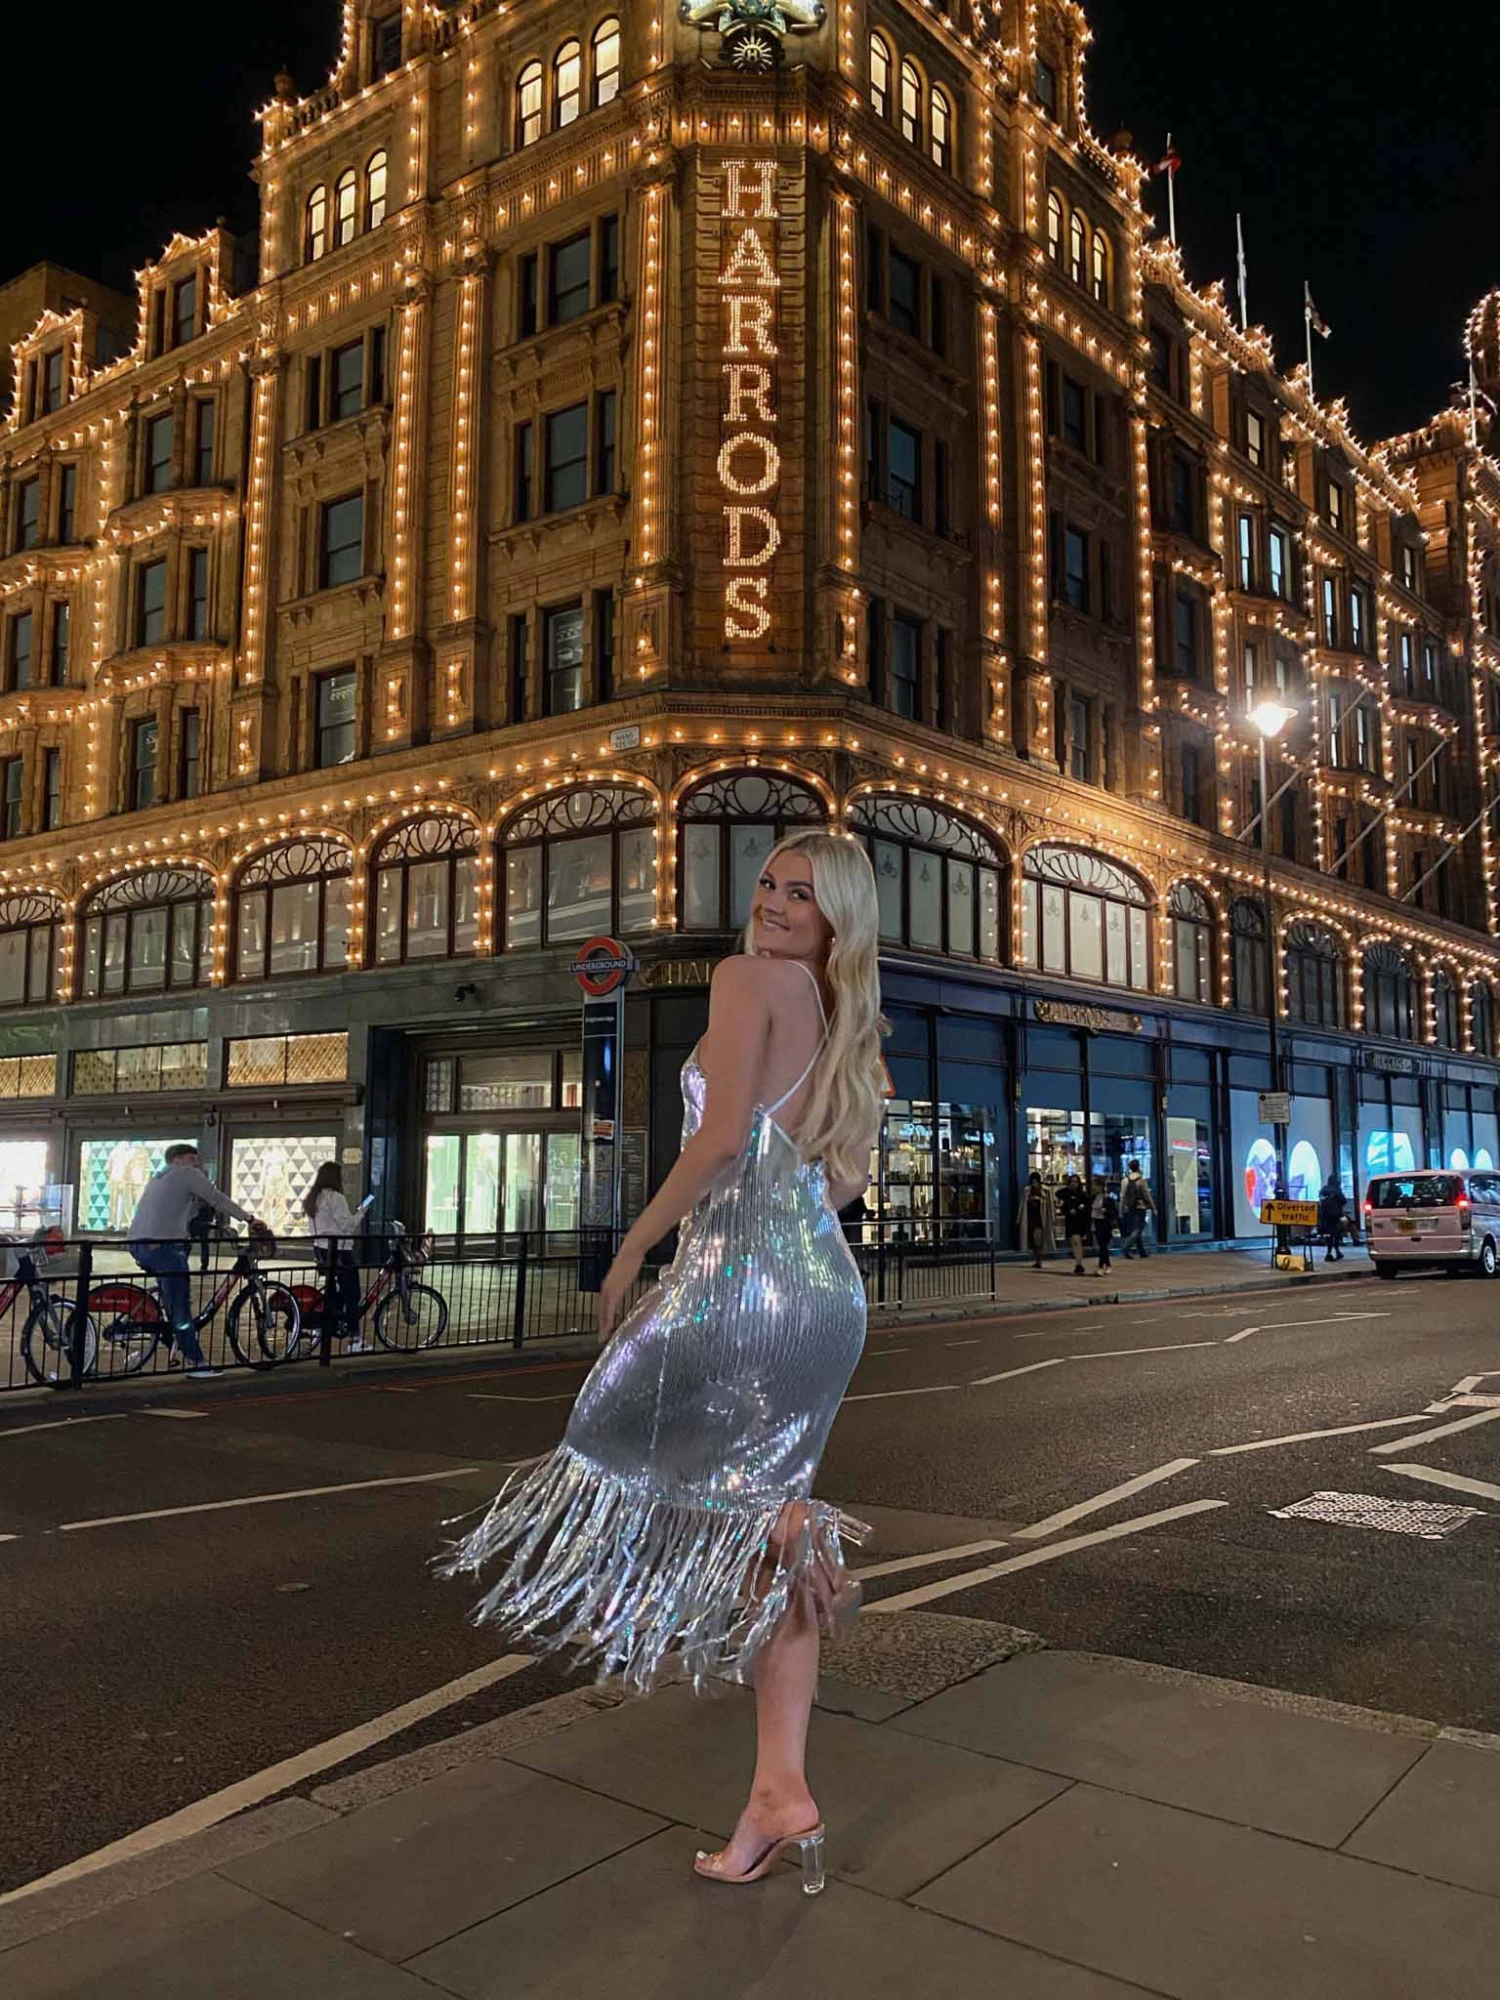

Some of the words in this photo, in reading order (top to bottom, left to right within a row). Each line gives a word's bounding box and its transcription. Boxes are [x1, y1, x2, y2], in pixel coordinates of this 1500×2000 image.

[717, 159, 781, 639] HARRODS
[571, 960, 627, 972] UNDERGROUND
[1277, 1202, 1316, 1212] Diverted
[1281, 1212, 1310, 1221] traffic
